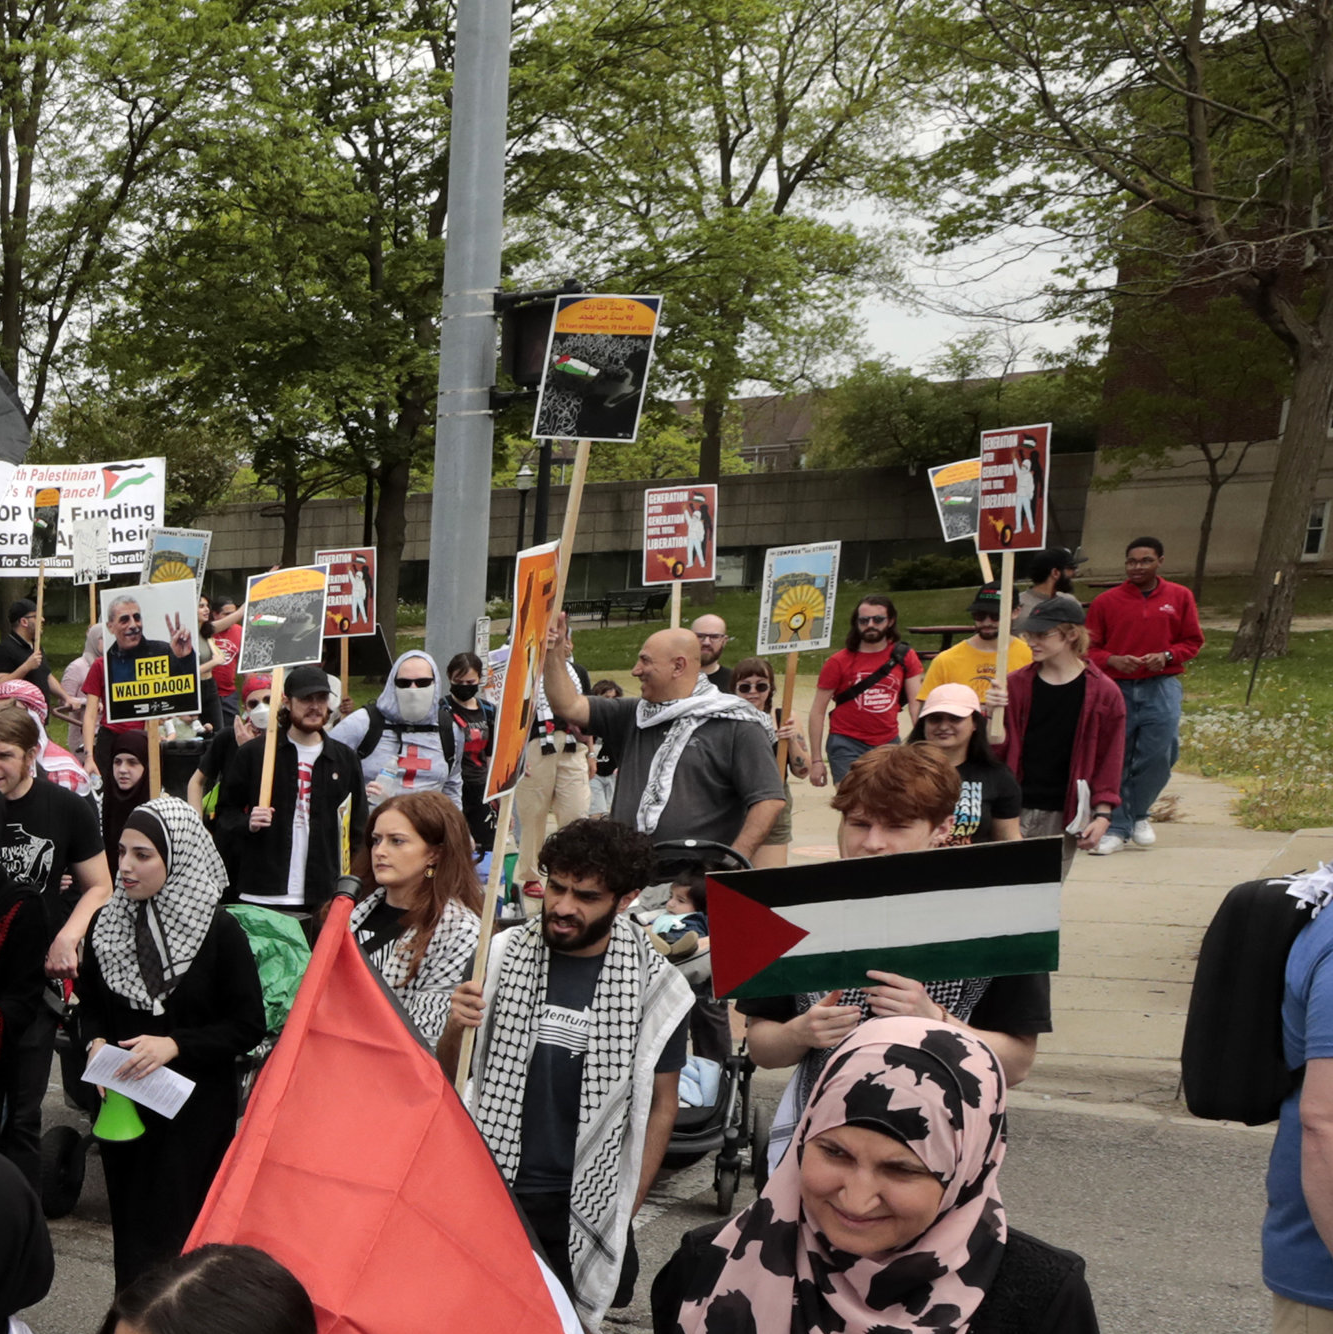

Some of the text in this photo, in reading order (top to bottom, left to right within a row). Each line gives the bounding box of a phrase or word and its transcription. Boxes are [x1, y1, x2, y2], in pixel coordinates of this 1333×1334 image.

[30, 466, 96, 482] Palestinian
[71, 502, 155, 522] Funding
[2, 556, 18, 567] for
[328, 574, 350, 584] ERATION
[327, 594, 352, 606] ERATION
[137, 659, 167, 677] FREE
[115, 677, 191, 699] WALID DAQQA
